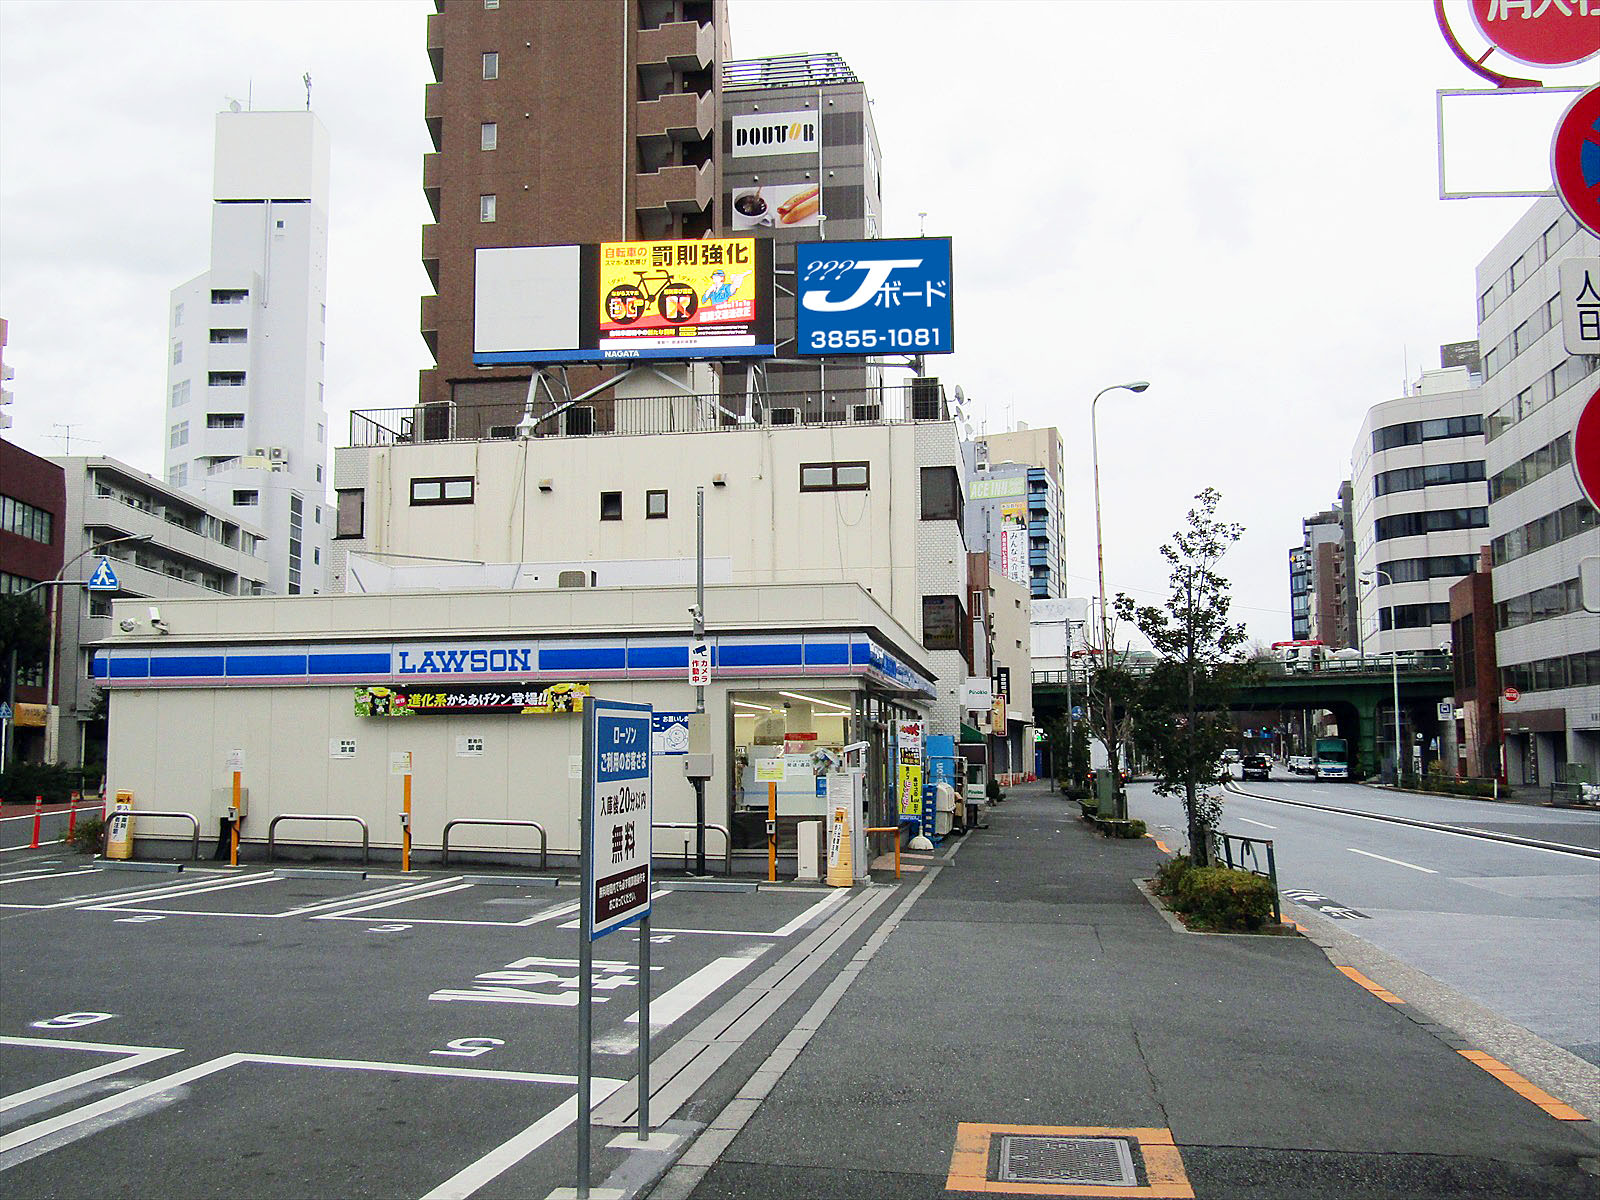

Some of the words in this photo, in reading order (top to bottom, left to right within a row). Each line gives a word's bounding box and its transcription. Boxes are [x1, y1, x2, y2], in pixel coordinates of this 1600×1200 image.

[736, 123, 814, 146] DOUTOR
[605, 247, 648, 259] 自転車の
[652, 243, 750, 267] 罰則強化
[811, 327, 940, 349] 3855-1081
[604, 350, 640, 358] NAGATA
[972, 484, 991, 498] ACE
[991, 479, 1008, 496] INN
[399, 649, 532, 673] LAWSON
[408, 691, 548, 708] 進化系からあげクン登場!!
[613, 727, 637, 744] ローソン
[600, 751, 647, 773] ご利用のお客さま
[600, 786, 647, 816] 入庫後20分以内
[612, 820, 636, 864] 無料
[365, 923, 413, 932] 3
[428, 1036, 506, 1057] 5
